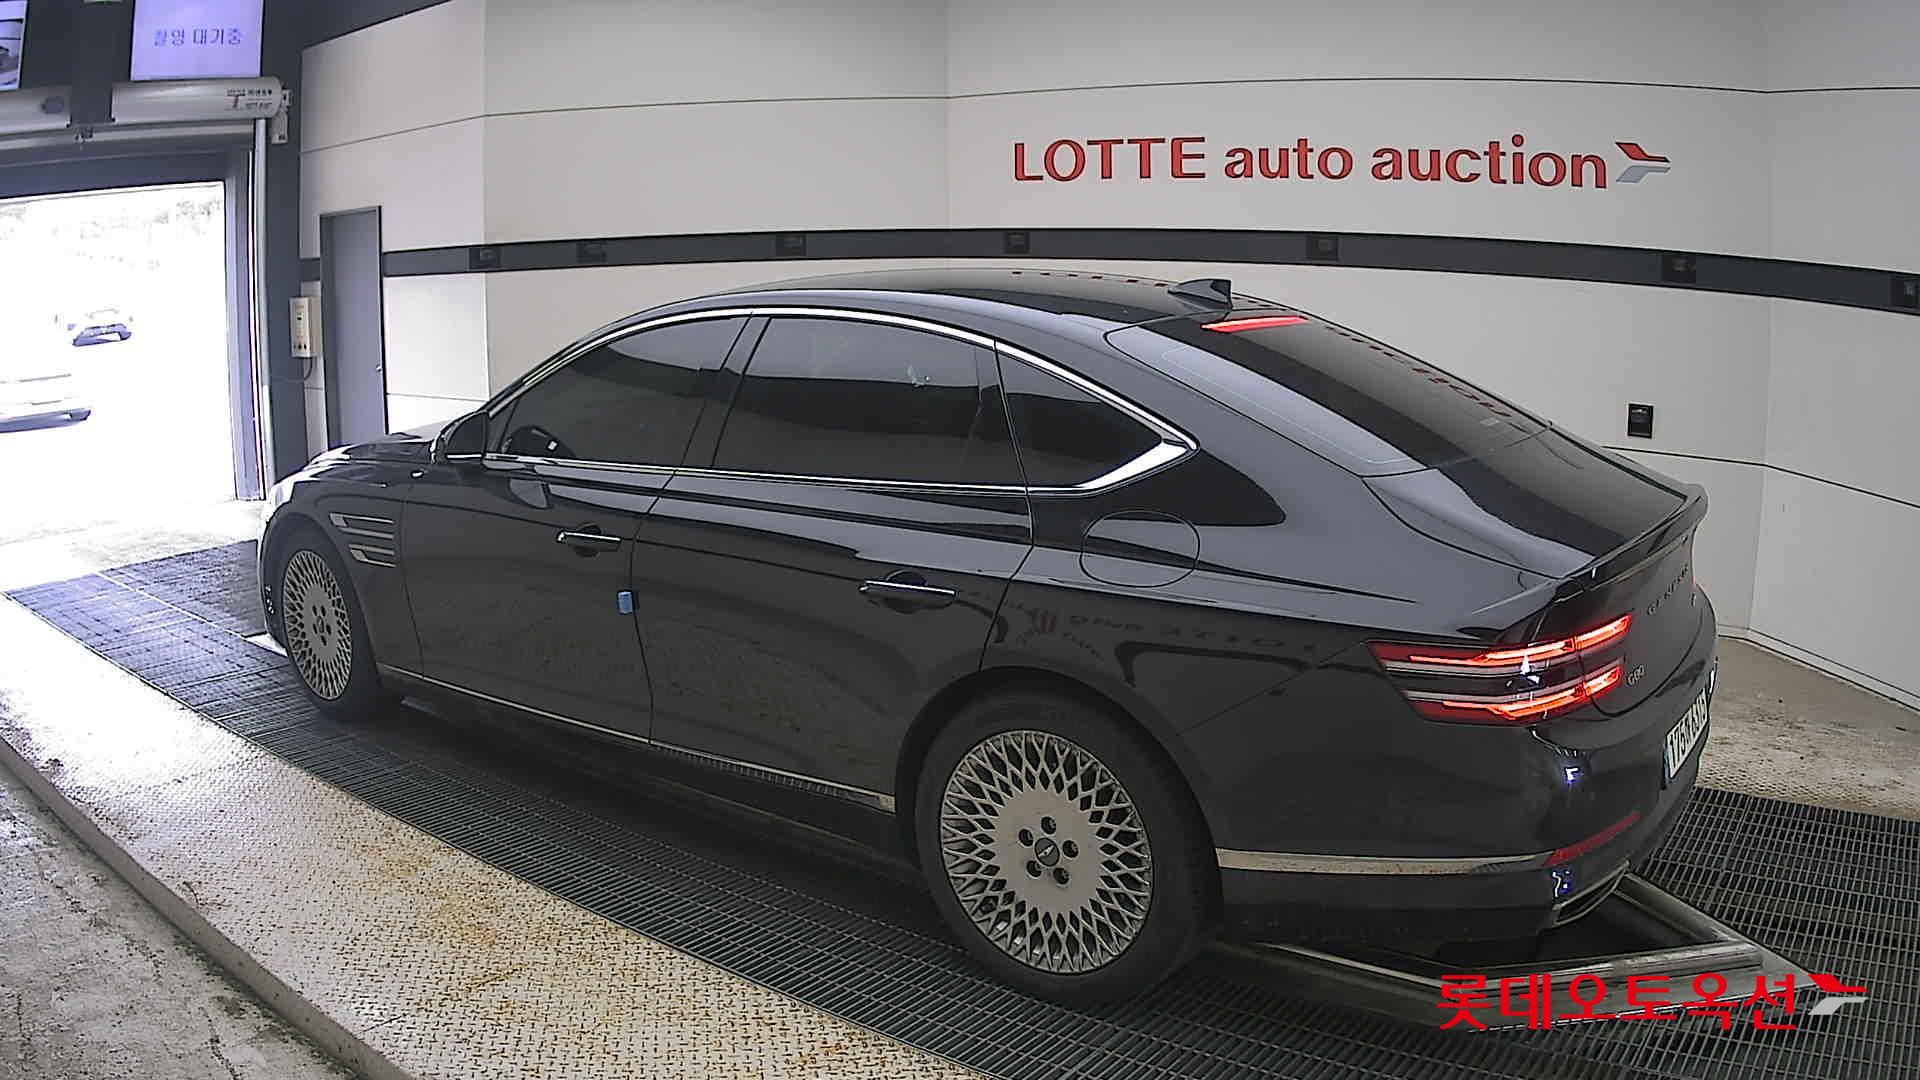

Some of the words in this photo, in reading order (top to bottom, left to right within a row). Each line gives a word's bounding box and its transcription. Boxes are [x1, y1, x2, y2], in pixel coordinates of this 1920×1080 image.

[1013, 136, 1206, 182] LOTTE
[1224, 137, 1354, 180] auto
[1370, 133, 1607, 189] auction
